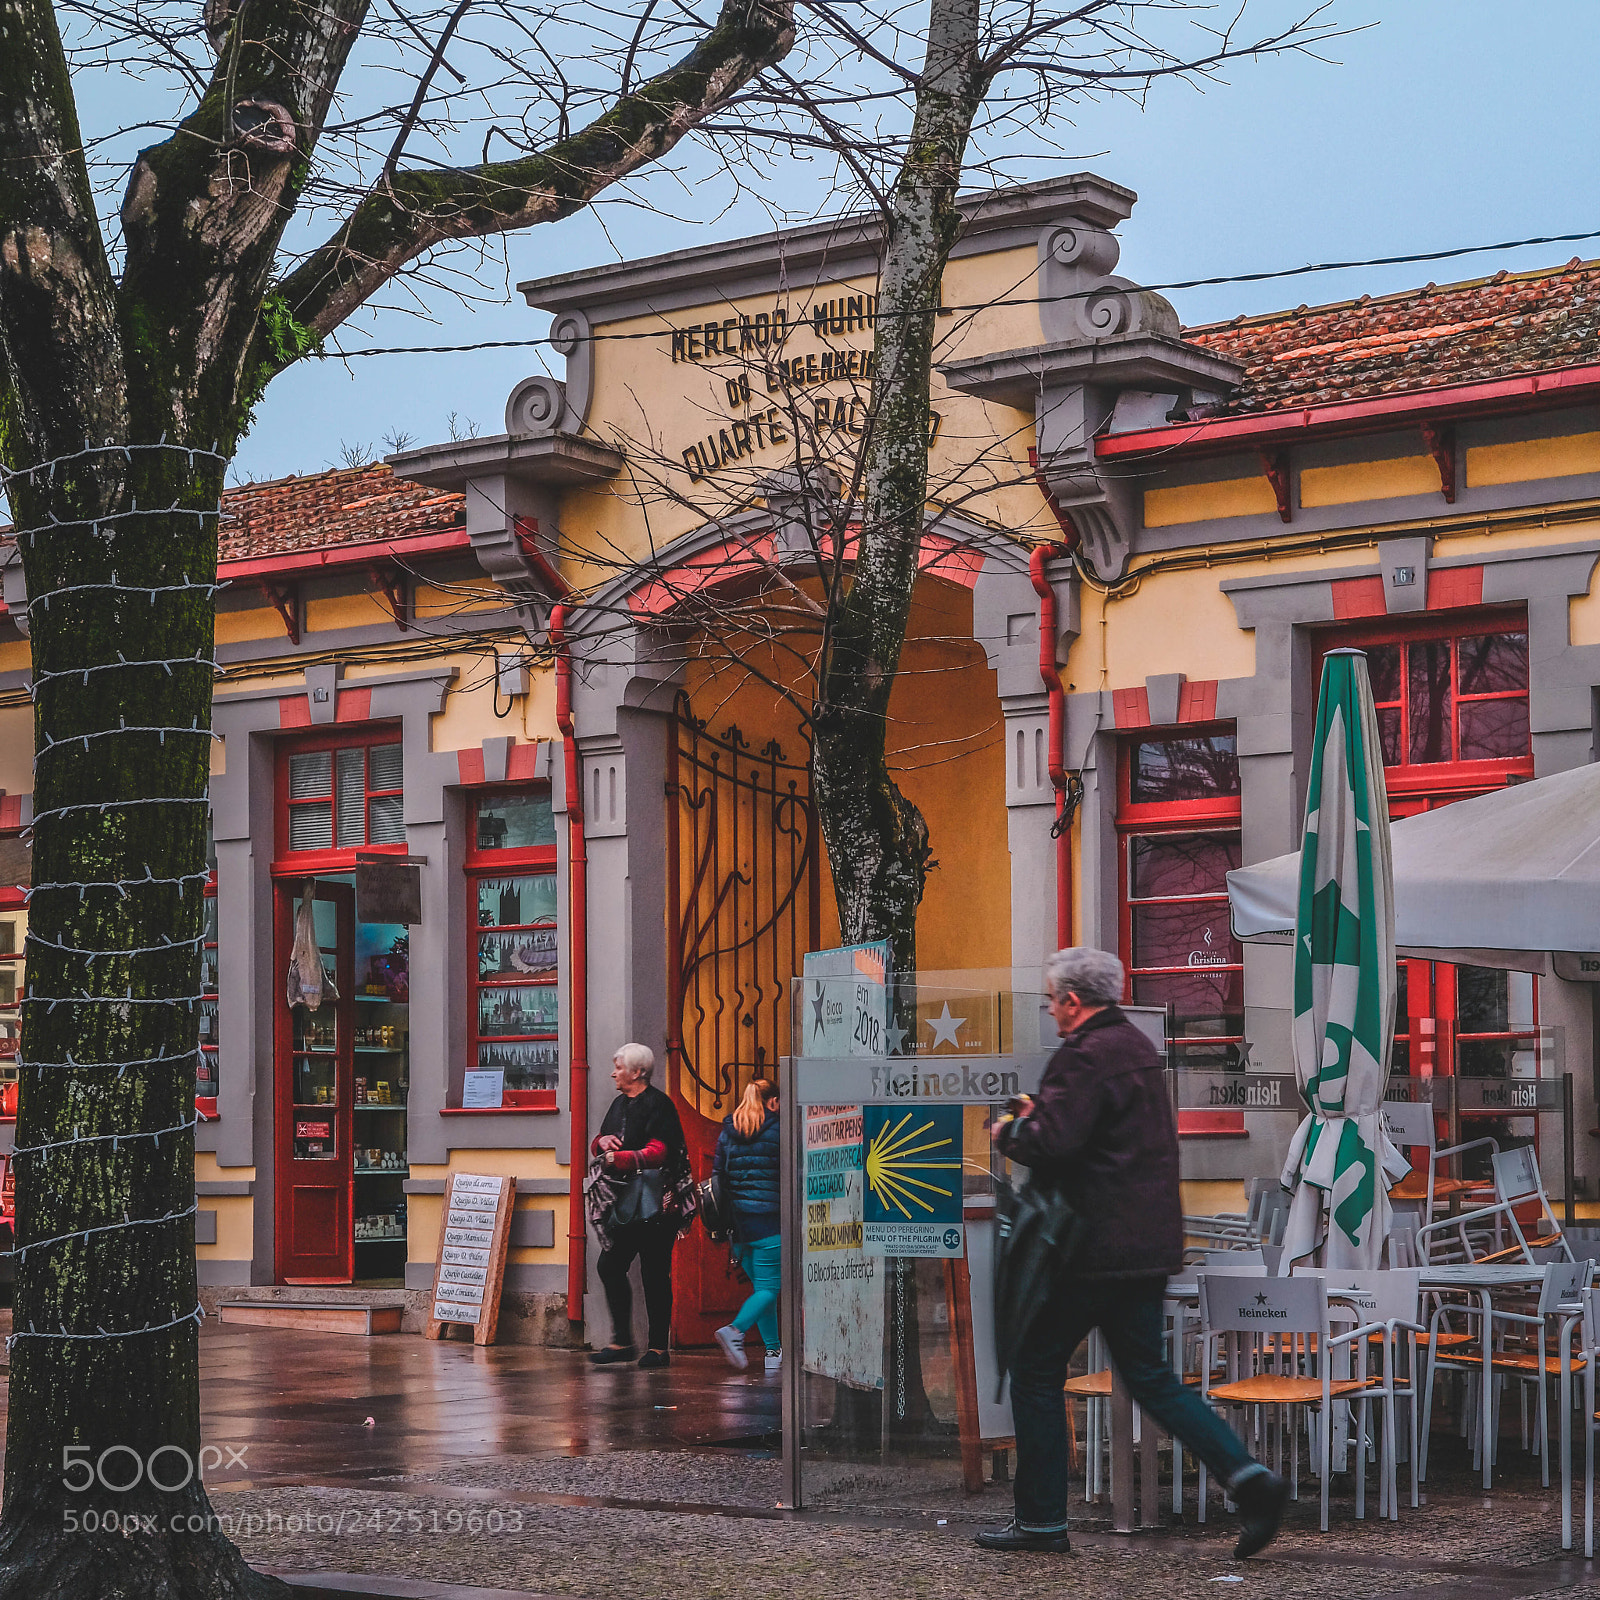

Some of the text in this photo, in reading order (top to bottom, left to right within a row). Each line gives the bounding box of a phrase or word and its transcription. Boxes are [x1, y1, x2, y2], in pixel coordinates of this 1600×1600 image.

[671, 308, 787, 363] MERCADO
[725, 373, 752, 409] DO
[1400, 568, 1407, 582] 6
[856, 984, 869, 1006] em
[854, 1006, 880, 1053] 2018
[870, 1064, 1021, 1097] Heineken
[808, 1117, 863, 1144] AUMENTAR PENS
[808, 1150, 840, 1173] INTEGRAR
[455, 1179, 471, 1189] Queijo
[808, 1173, 844, 1195] DO ESTADO
[454, 1196, 471, 1206] Queijo
[449, 1214, 466, 1224] Queijo
[808, 1204, 827, 1224] SUBIR
[865, 1225, 885, 1233] MENU
[898, 1226, 935, 1234] PEREGRINO
[446, 1232, 463, 1243] Queijo
[912, 1235, 942, 1243] PILGRIM
[945, 1234, 959, 1245] 5€
[444, 1250, 460, 1261] Queijo
[444, 1269, 460, 1280] Queijo
[808, 1263, 813, 1282] O
[814, 1261, 830, 1281] Bloco
[438, 1286, 454, 1298] Queijo
[437, 1306, 453, 1318] Queijo
[1238, 1307, 1287, 1318] Heineken
